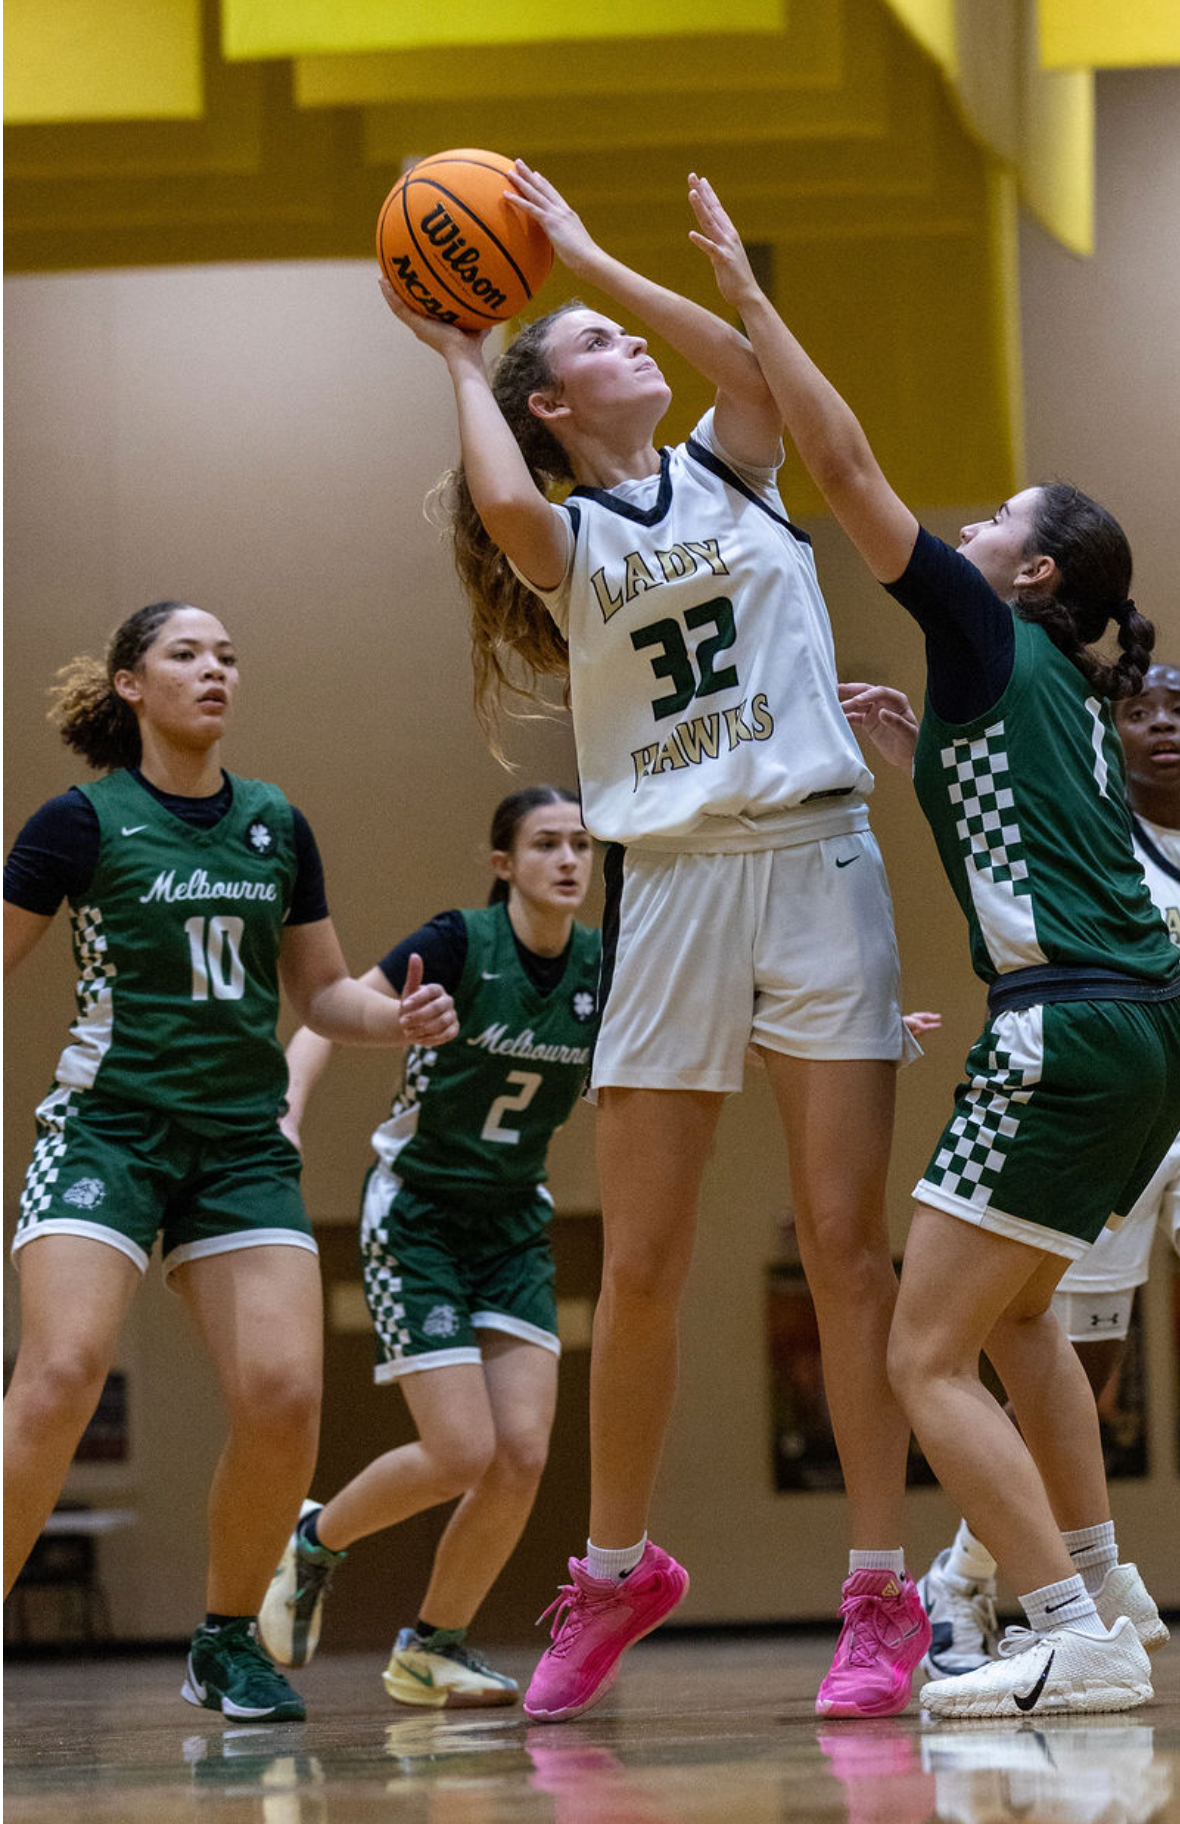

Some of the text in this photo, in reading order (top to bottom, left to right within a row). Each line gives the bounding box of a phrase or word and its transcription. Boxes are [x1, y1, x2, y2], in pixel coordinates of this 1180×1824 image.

[420, 203, 507, 311] Wilson
[590, 538, 730, 625] LADY
[629, 595, 740, 722] 32
[630, 693, 775, 794] HAWKS
[140, 869, 277, 904] Melbourne
[184, 916, 246, 1001] 10
[466, 1023, 590, 1065] Melbourne
[480, 1071, 543, 1145] 2
